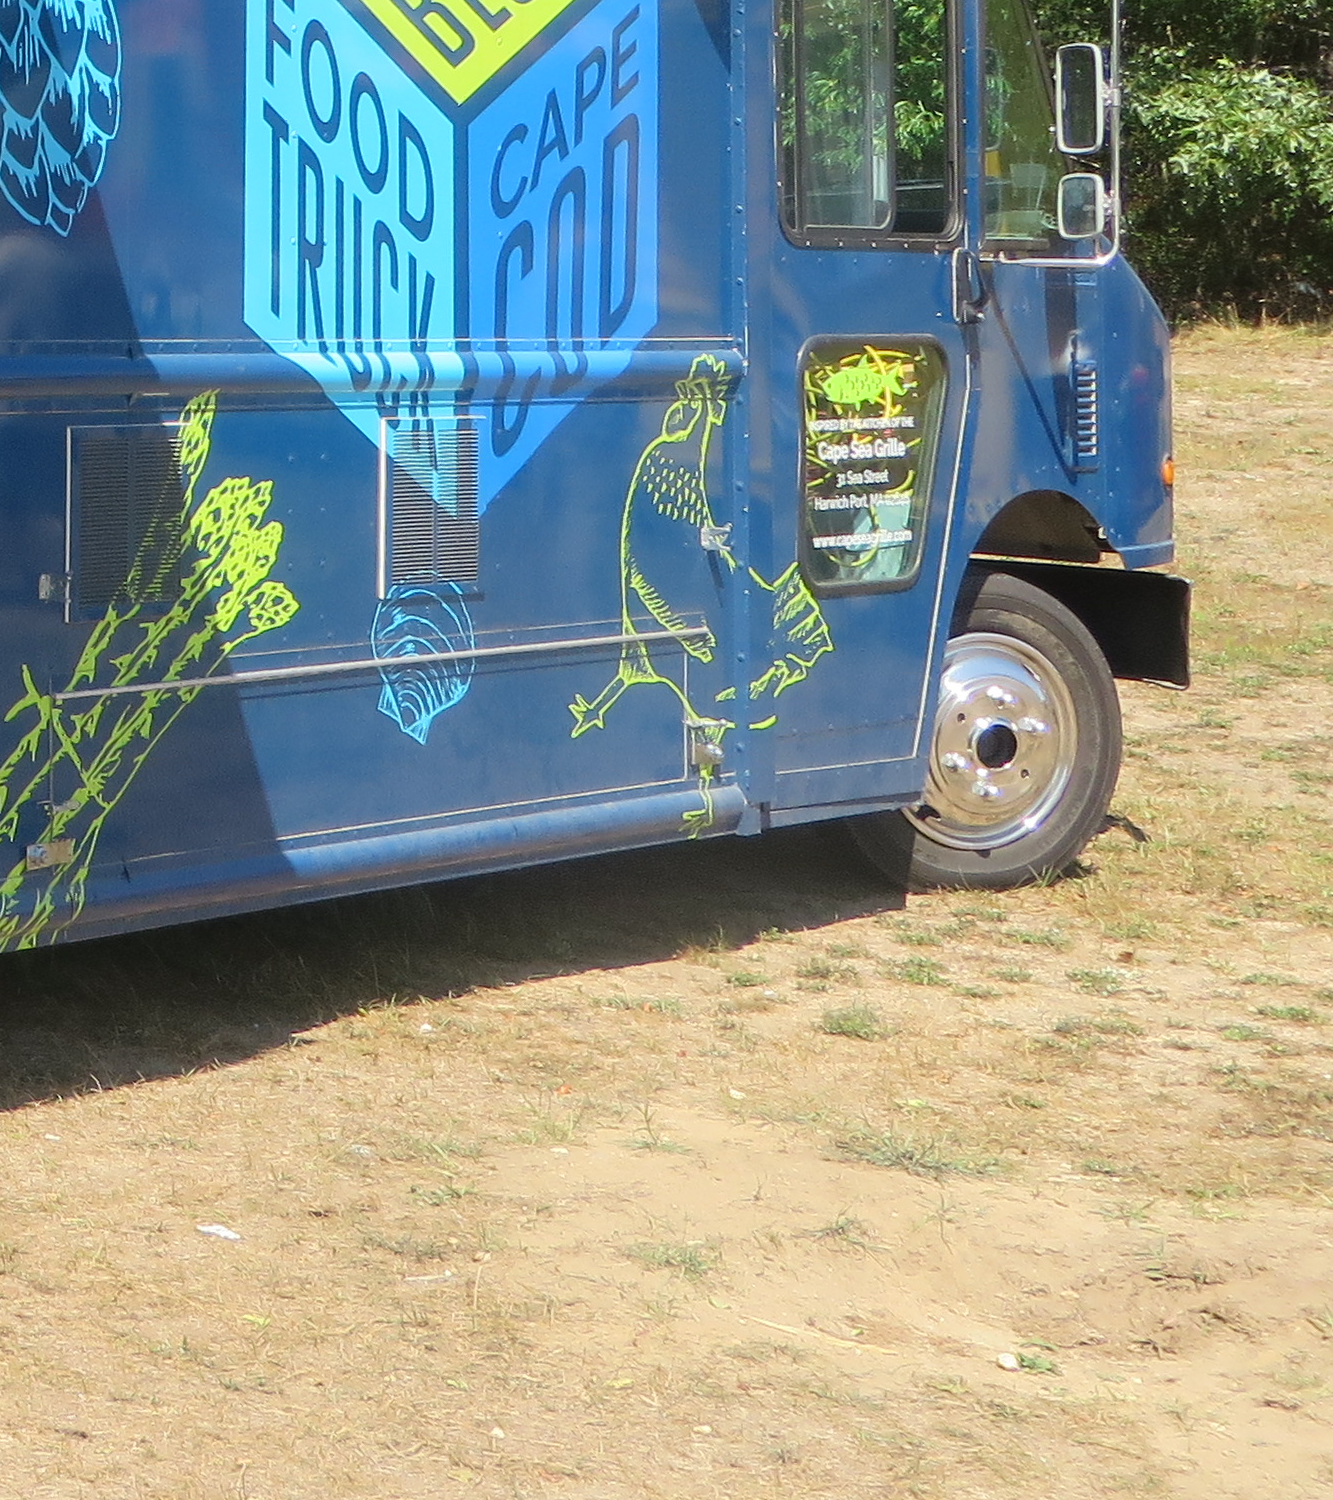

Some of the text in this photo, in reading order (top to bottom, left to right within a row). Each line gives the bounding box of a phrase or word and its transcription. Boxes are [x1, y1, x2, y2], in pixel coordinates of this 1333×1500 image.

[490, 3, 641, 219] CAPE
[262, 96, 439, 472] TRUCK
[491, 112, 639, 458] COD
[814, 495, 849, 511] Harwich
[818, 437, 906, 465] Cape Sea Grille
[846, 470, 863, 485] Sea
[864, 469, 889, 484] Street
